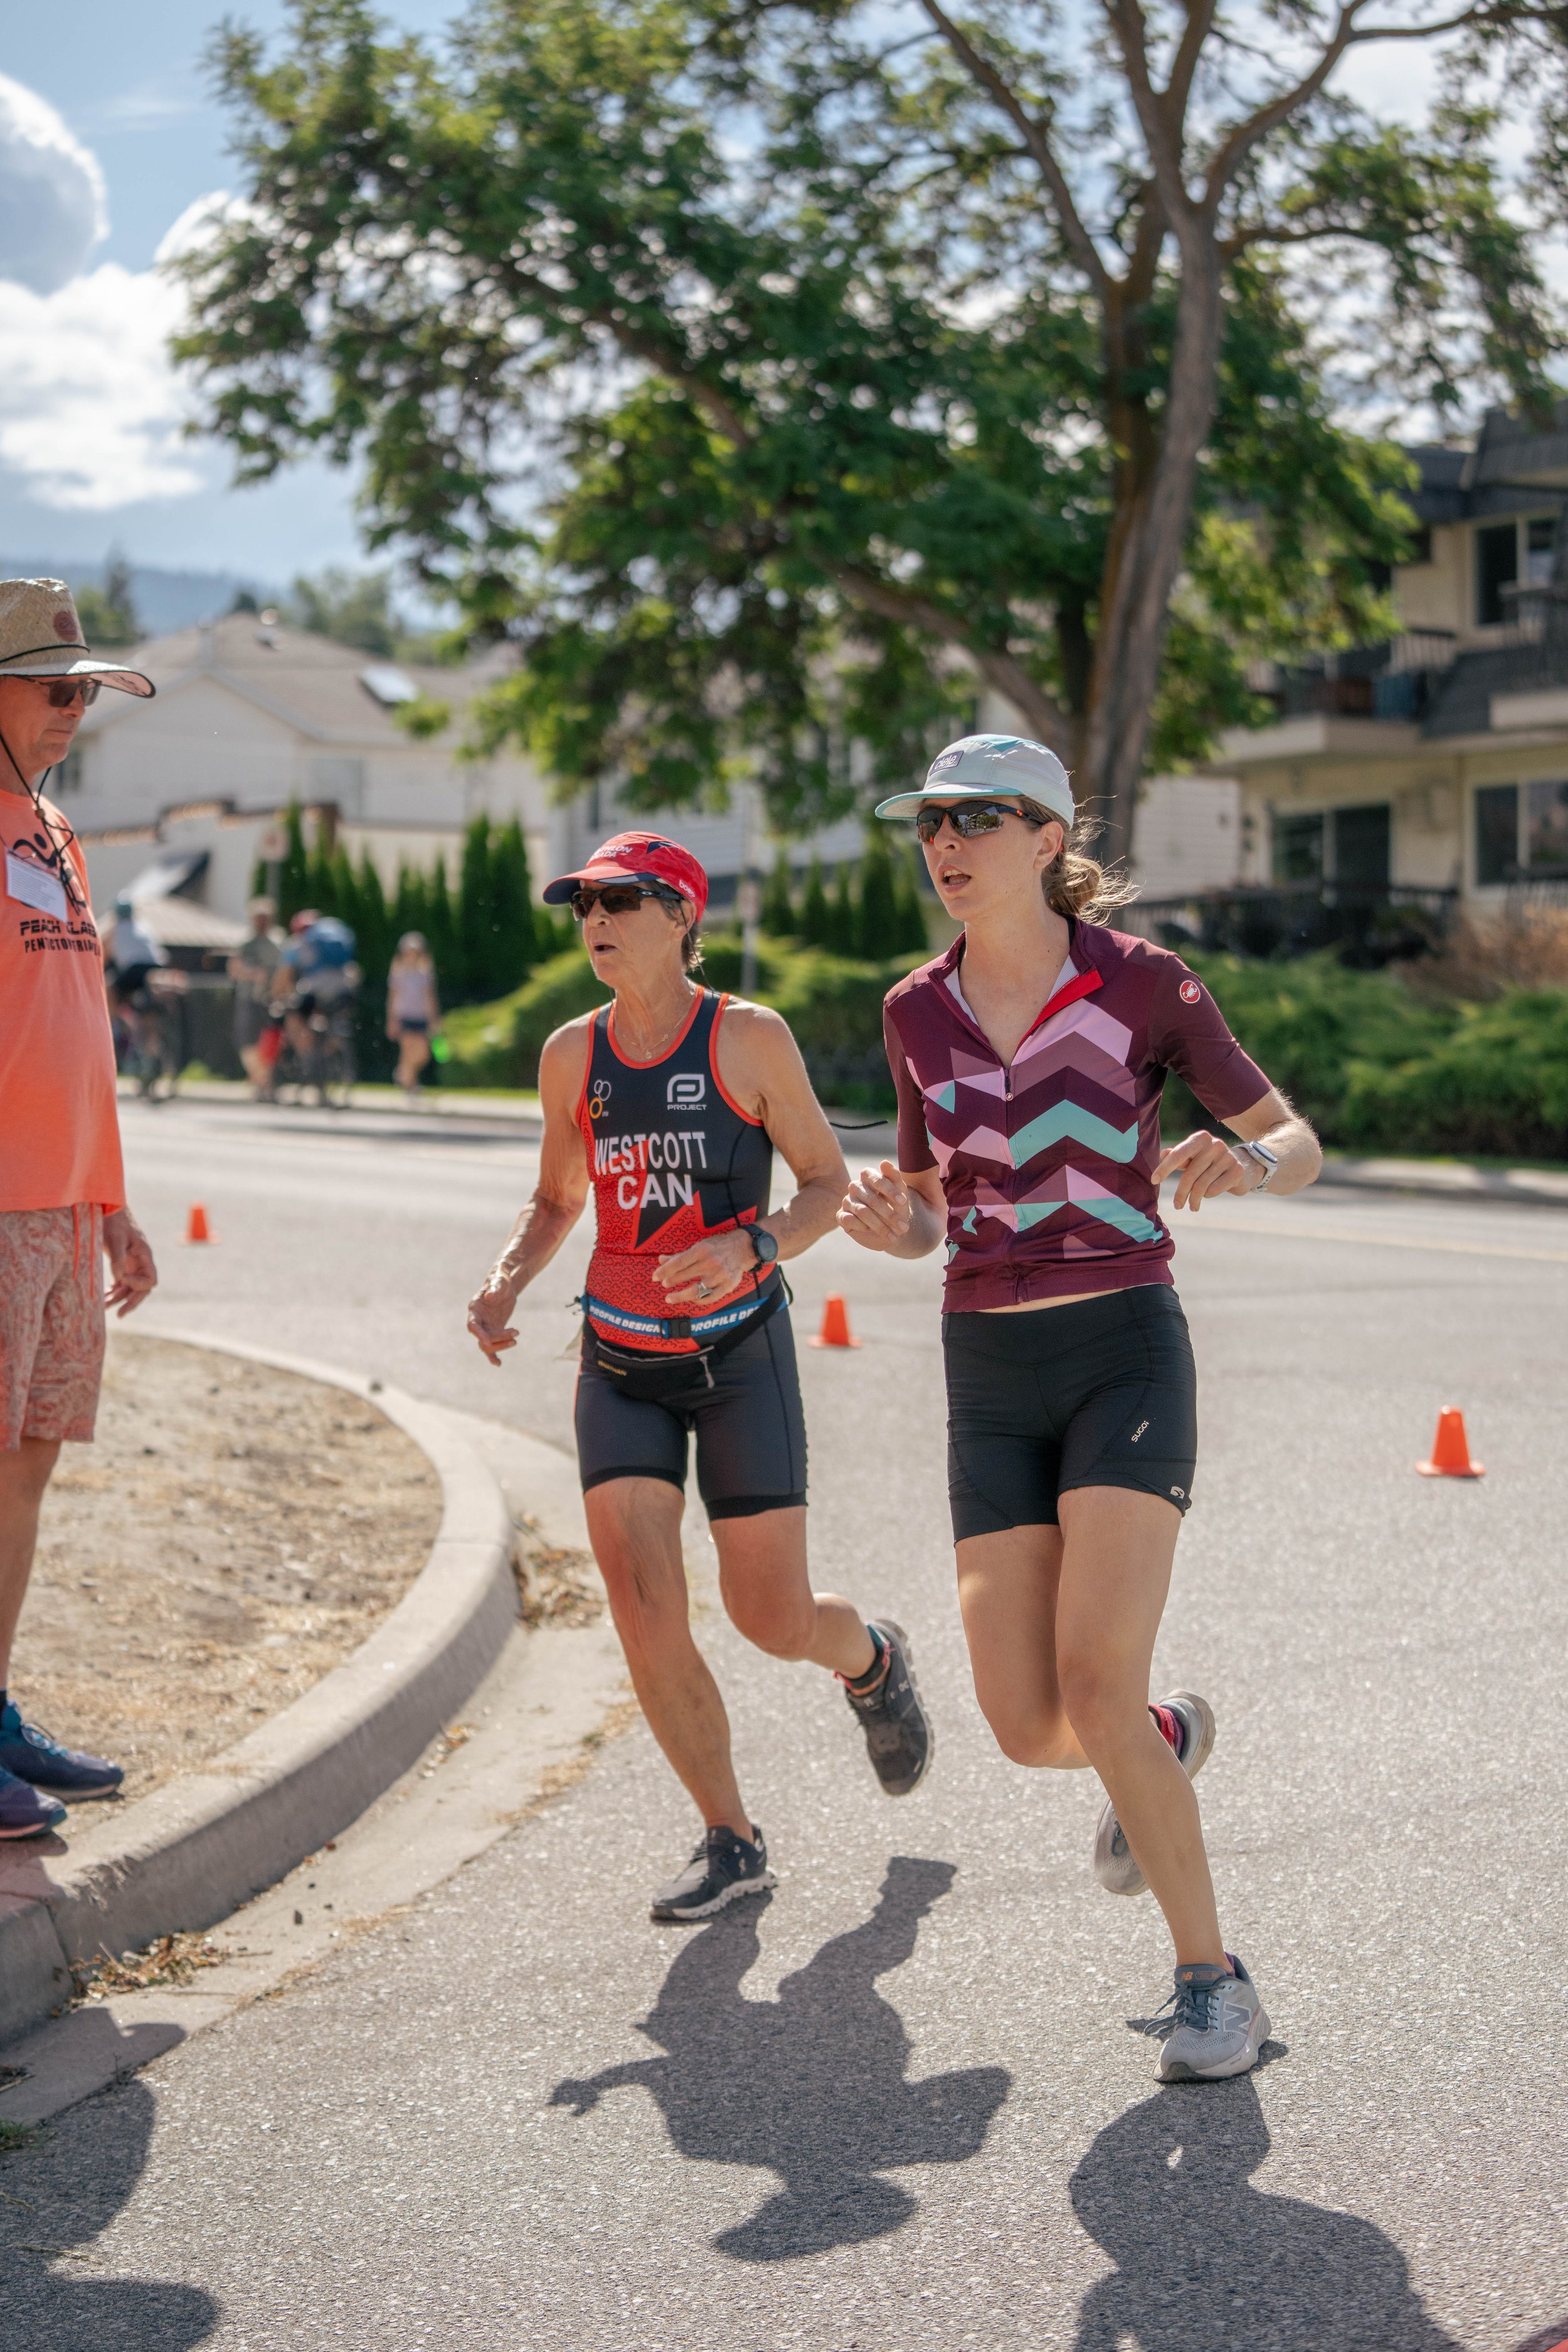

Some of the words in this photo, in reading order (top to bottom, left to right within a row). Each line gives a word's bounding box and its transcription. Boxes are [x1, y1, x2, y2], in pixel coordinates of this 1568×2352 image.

[595, 1131, 707, 1176] WESTCOTT
[617, 1172, 694, 1210] CAN
[589, 1305, 622, 1325] PROFILE
